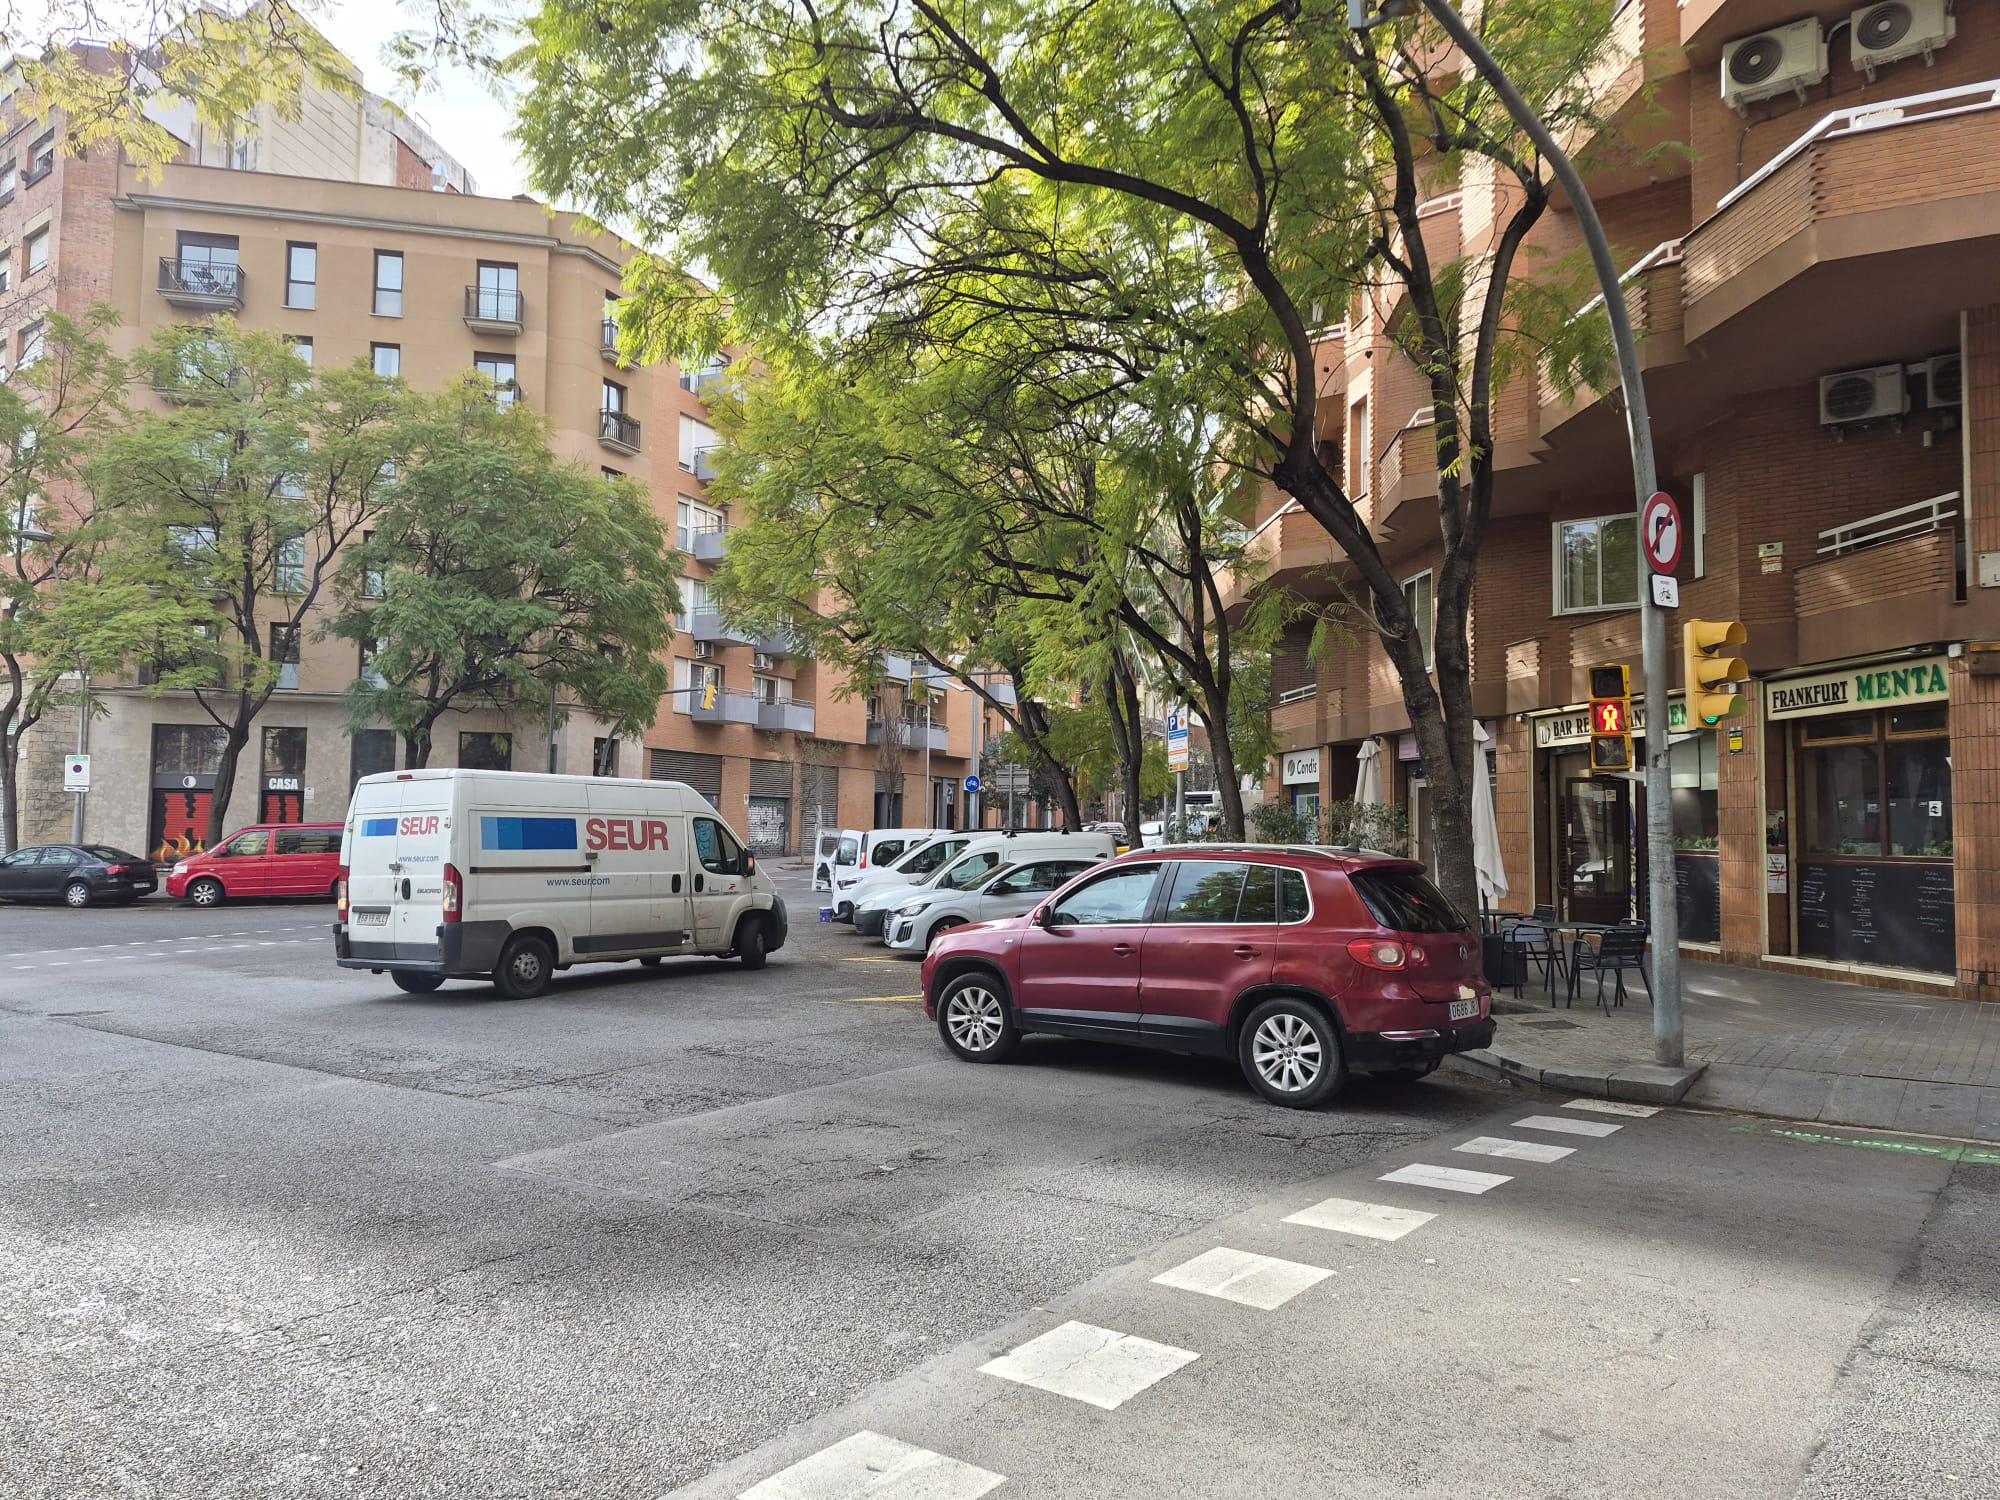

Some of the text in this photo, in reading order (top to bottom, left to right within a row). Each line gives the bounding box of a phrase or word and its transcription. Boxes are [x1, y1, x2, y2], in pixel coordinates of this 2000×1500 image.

[1772, 663, 1947, 709] FRANKFURT MENTA
[1169, 716, 1176, 731] P
[1553, 719, 1572, 737] BAR
[268, 777, 299, 790] CASA
[400, 816, 440, 836] SEUR
[586, 818, 669, 851] SEUR
[398, 855, 440, 864] www.seur.com
[546, 876, 611, 887] www.seur.com
